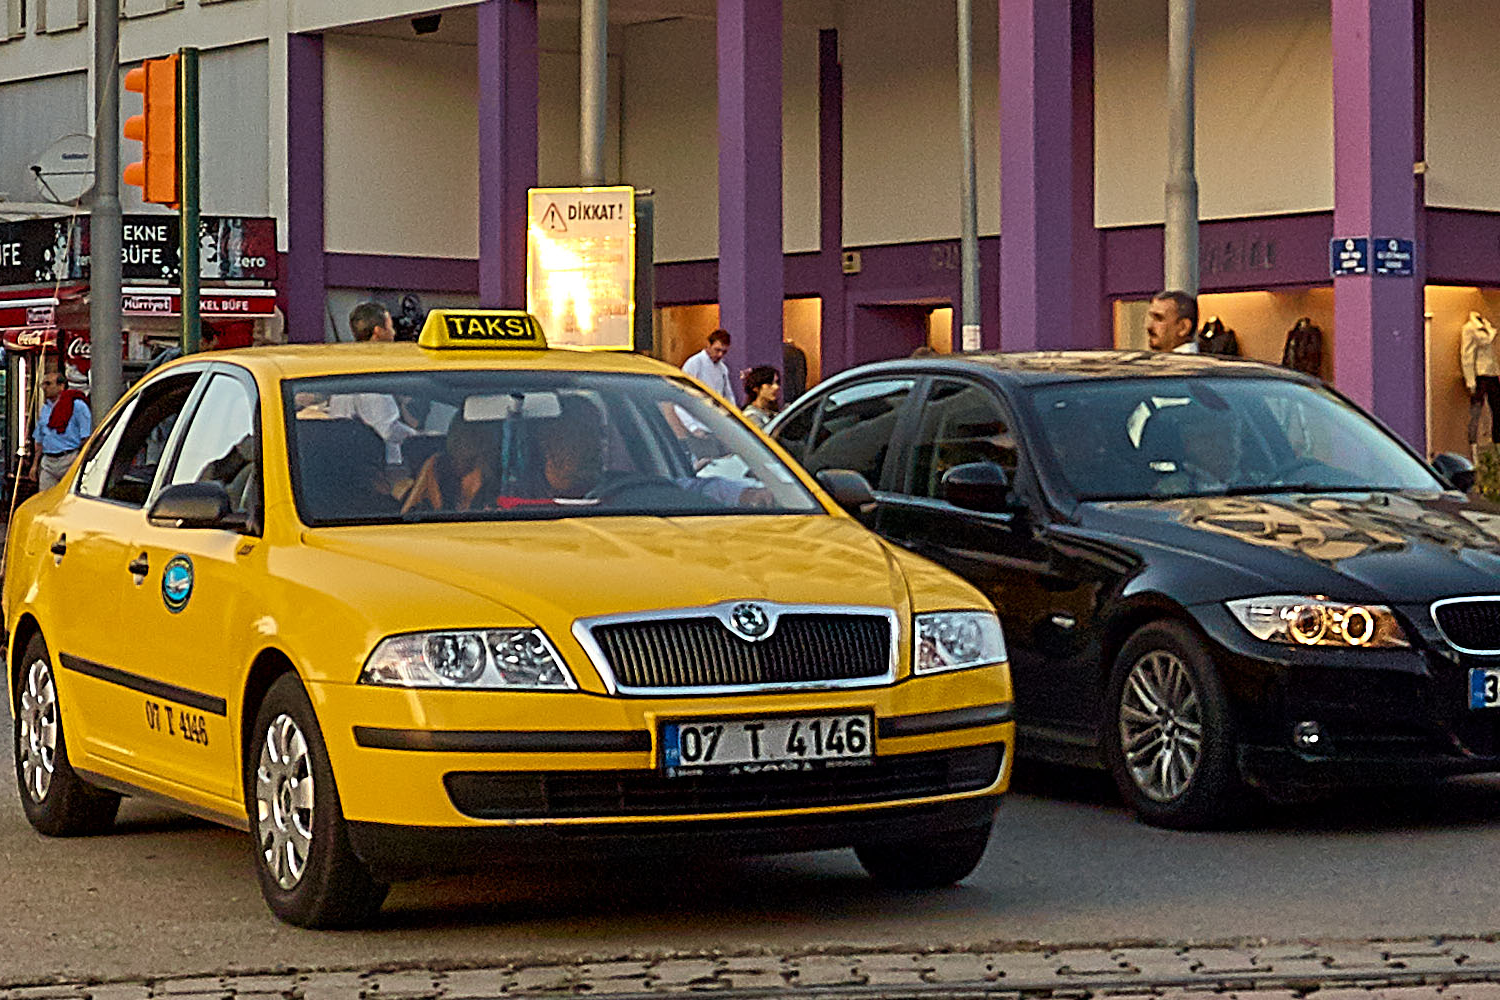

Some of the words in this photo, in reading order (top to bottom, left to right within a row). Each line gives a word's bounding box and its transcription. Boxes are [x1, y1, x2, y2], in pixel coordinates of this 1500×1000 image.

[568, 201, 615, 220] DİKKAT
[123, 225, 167, 242] EKNE
[234, 256, 266, 268] zero
[222, 299, 249, 311] BÜFE
[146, 700, 160, 731] 07
[164, 705, 175, 735] T
[179, 711, 208, 746] 4146
[681, 725, 723, 762] 07
[744, 723, 764, 760] T
[786, 718, 867, 757] 4146
